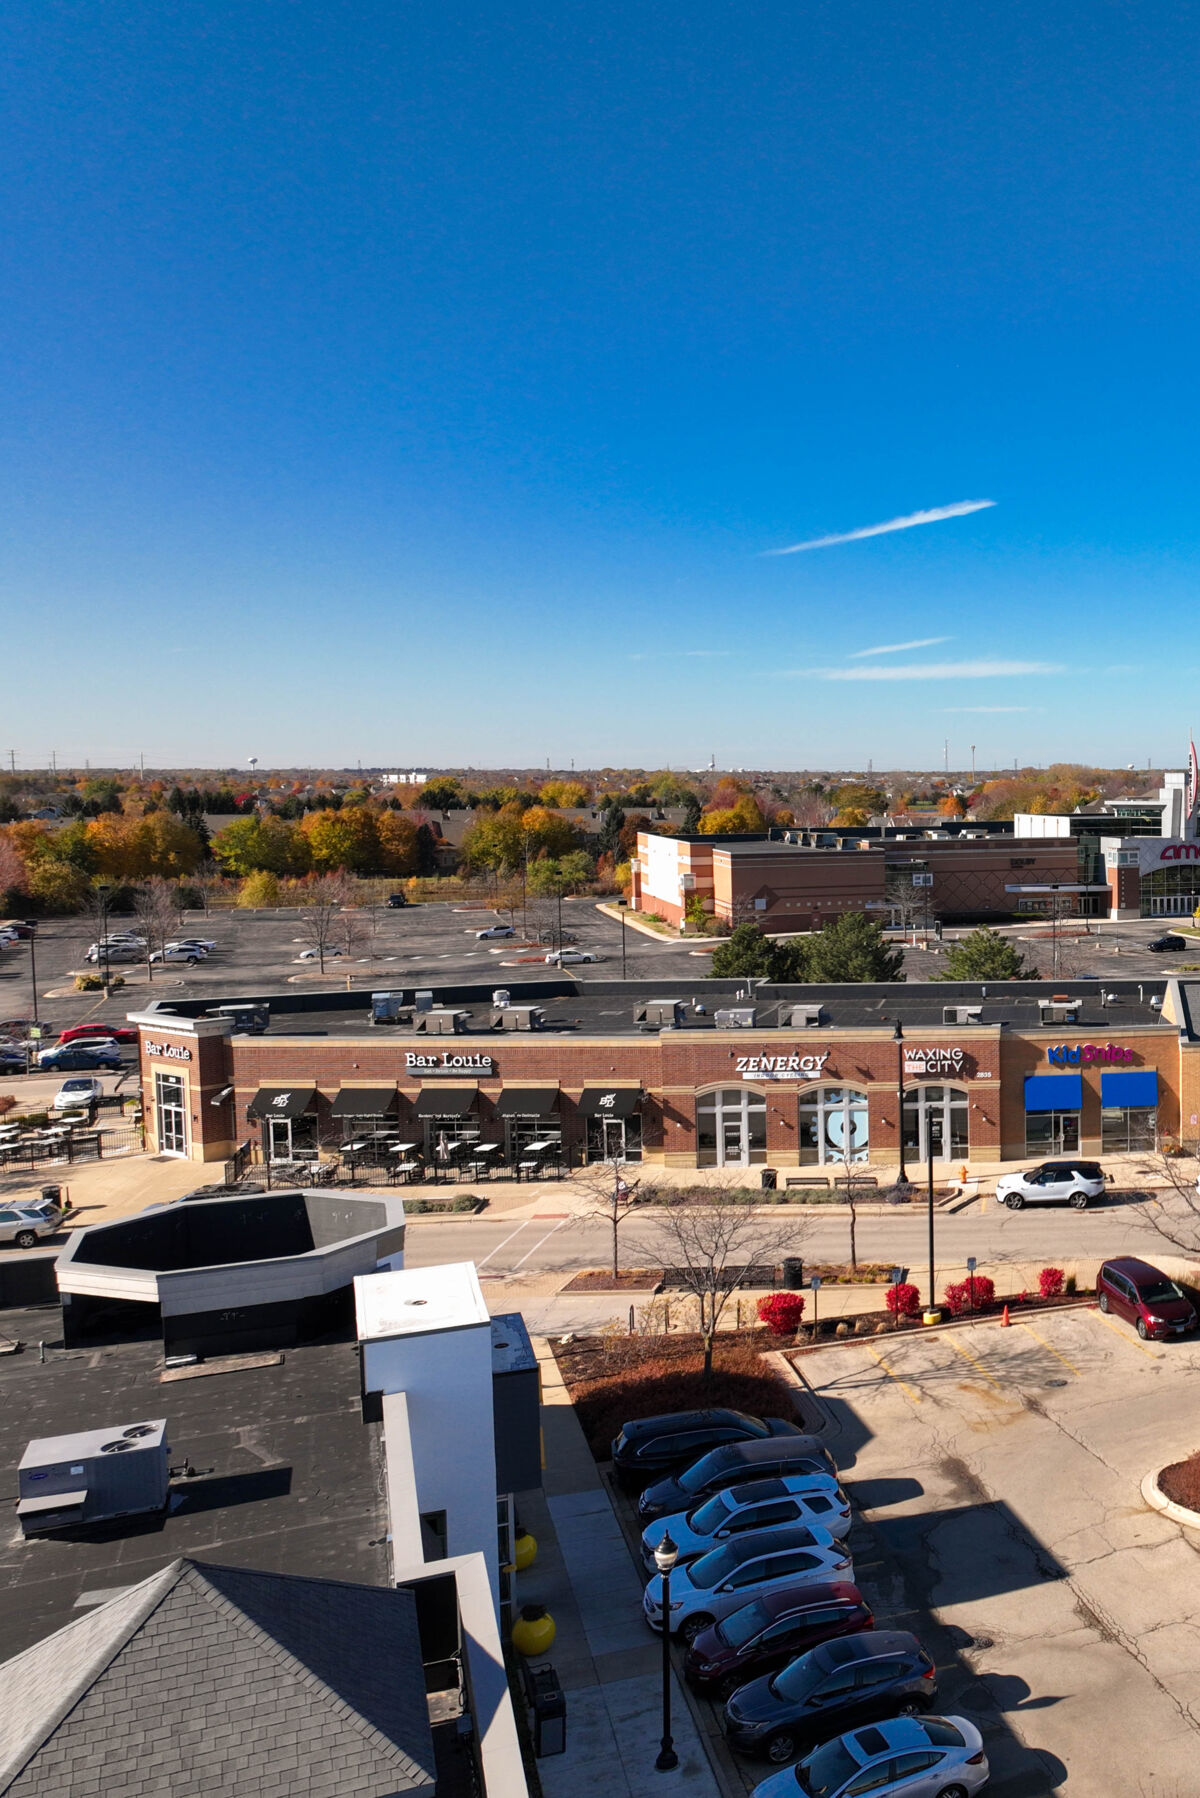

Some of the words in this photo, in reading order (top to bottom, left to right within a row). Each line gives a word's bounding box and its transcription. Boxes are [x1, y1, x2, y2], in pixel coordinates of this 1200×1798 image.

[145, 1040, 162, 1056] Bar
[163, 1043, 190, 1061] Louie
[903, 1048, 963, 1060] WAXING
[404, 1052, 437, 1067] Bar
[441, 1052, 492, 1067] Louie
[735, 1056, 827, 1071] ZENERGY
[906, 1063, 924, 1071] THE
[926, 1060, 964, 1073] CITY
